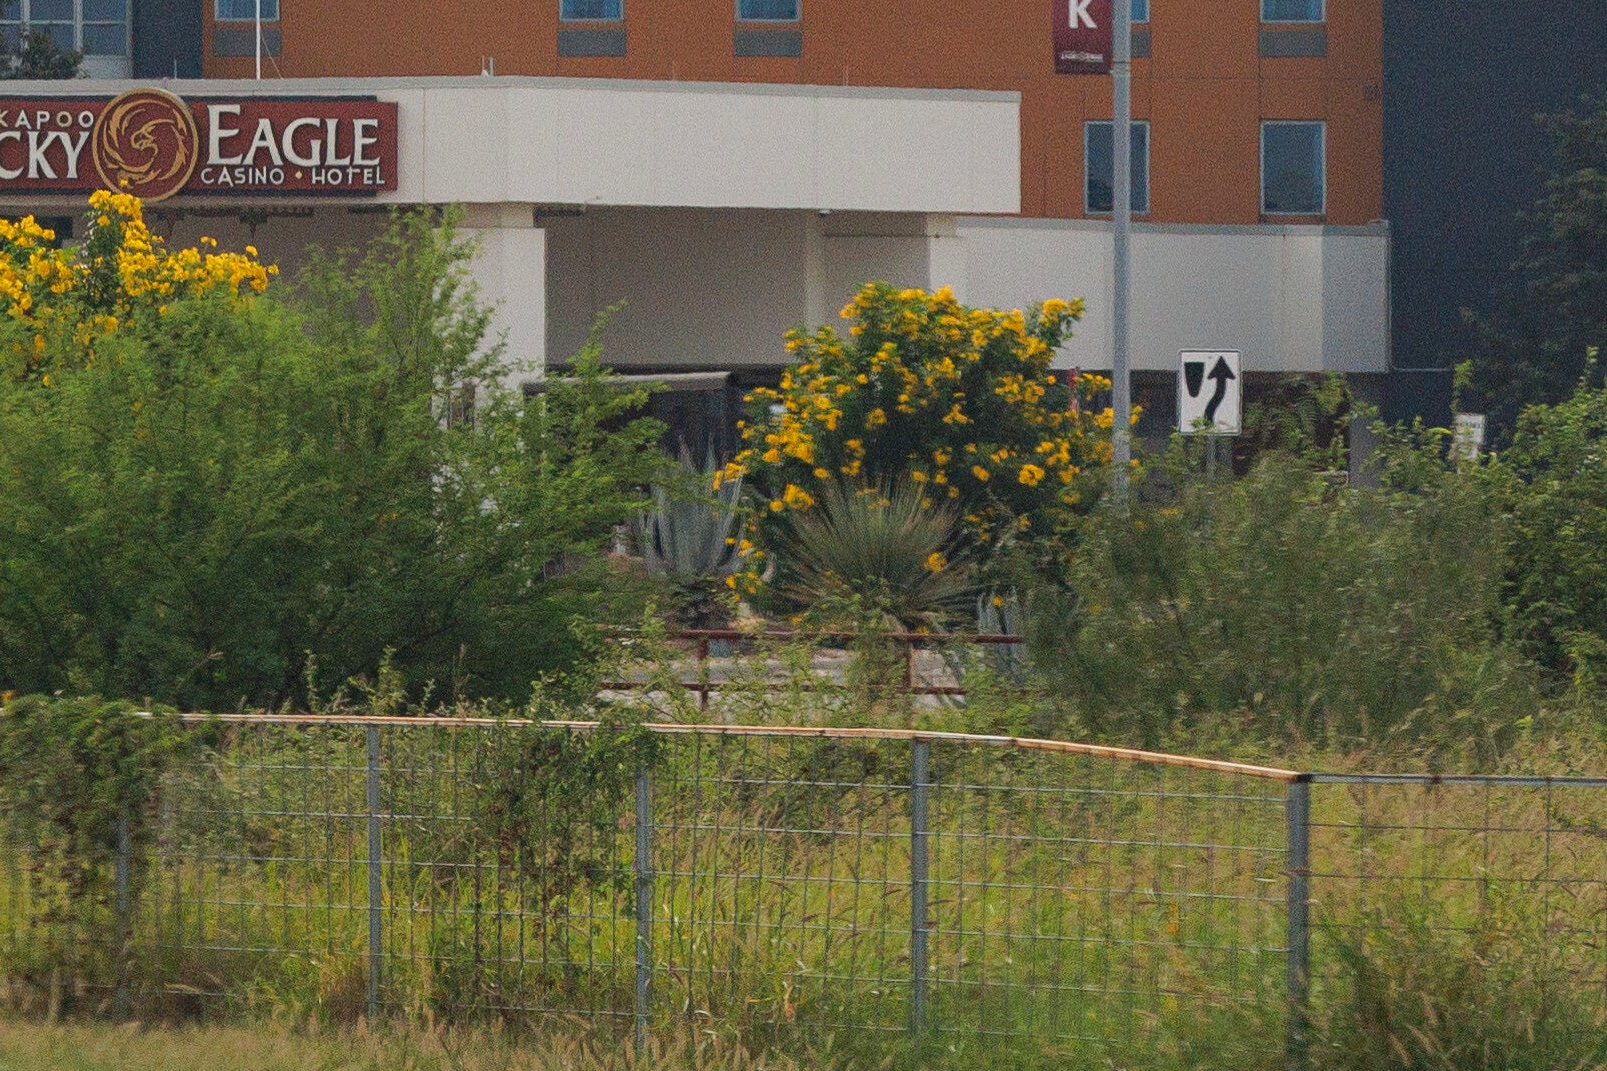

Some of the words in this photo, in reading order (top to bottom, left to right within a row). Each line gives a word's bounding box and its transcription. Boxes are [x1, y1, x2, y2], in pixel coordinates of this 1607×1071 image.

[206, 104, 380, 167] EAGLE
[200, 166, 285, 187] CASINO
[311, 166, 385, 186] HOTEL
